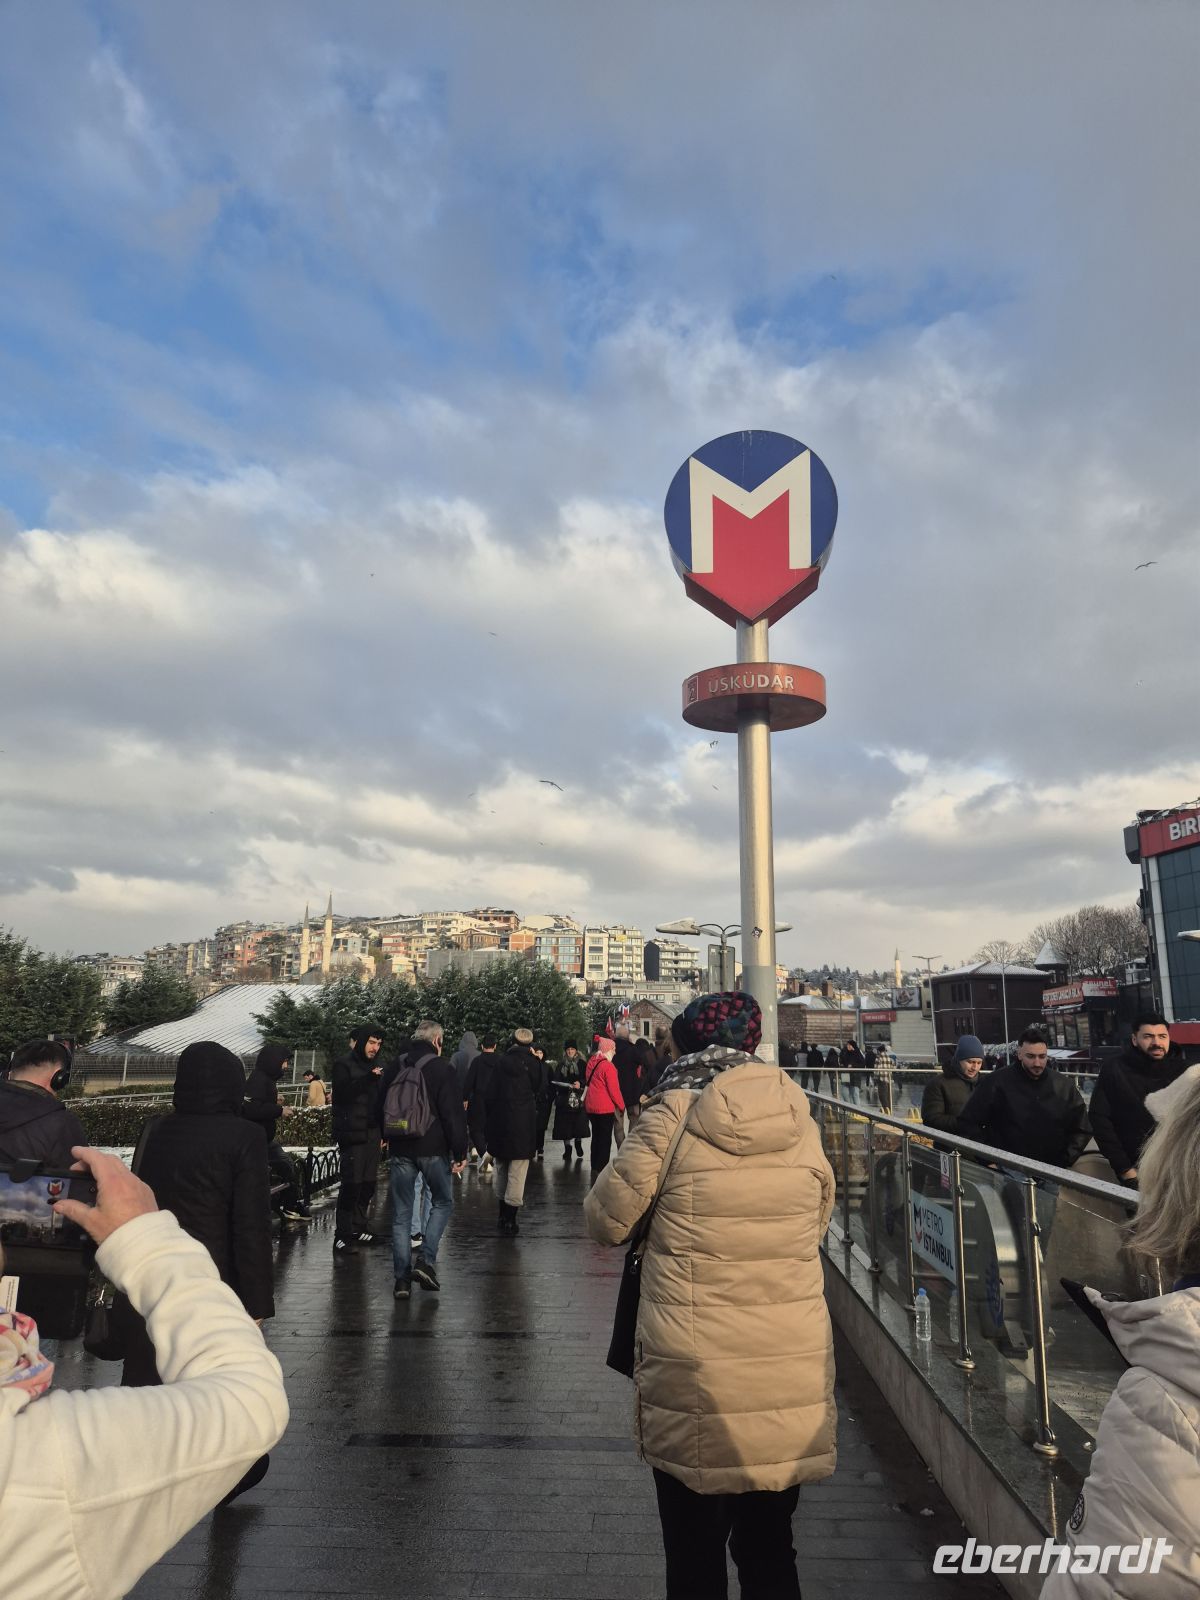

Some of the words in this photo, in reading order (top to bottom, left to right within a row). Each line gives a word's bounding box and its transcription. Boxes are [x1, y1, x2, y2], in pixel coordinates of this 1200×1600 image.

[689, 448, 812, 573] M
[708, 671, 795, 693] ÜSKÜDAR
[1168, 815, 1200, 841] BİR
[922, 1207, 944, 1237] METRO
[922, 1229, 955, 1271] İSTANBUL
